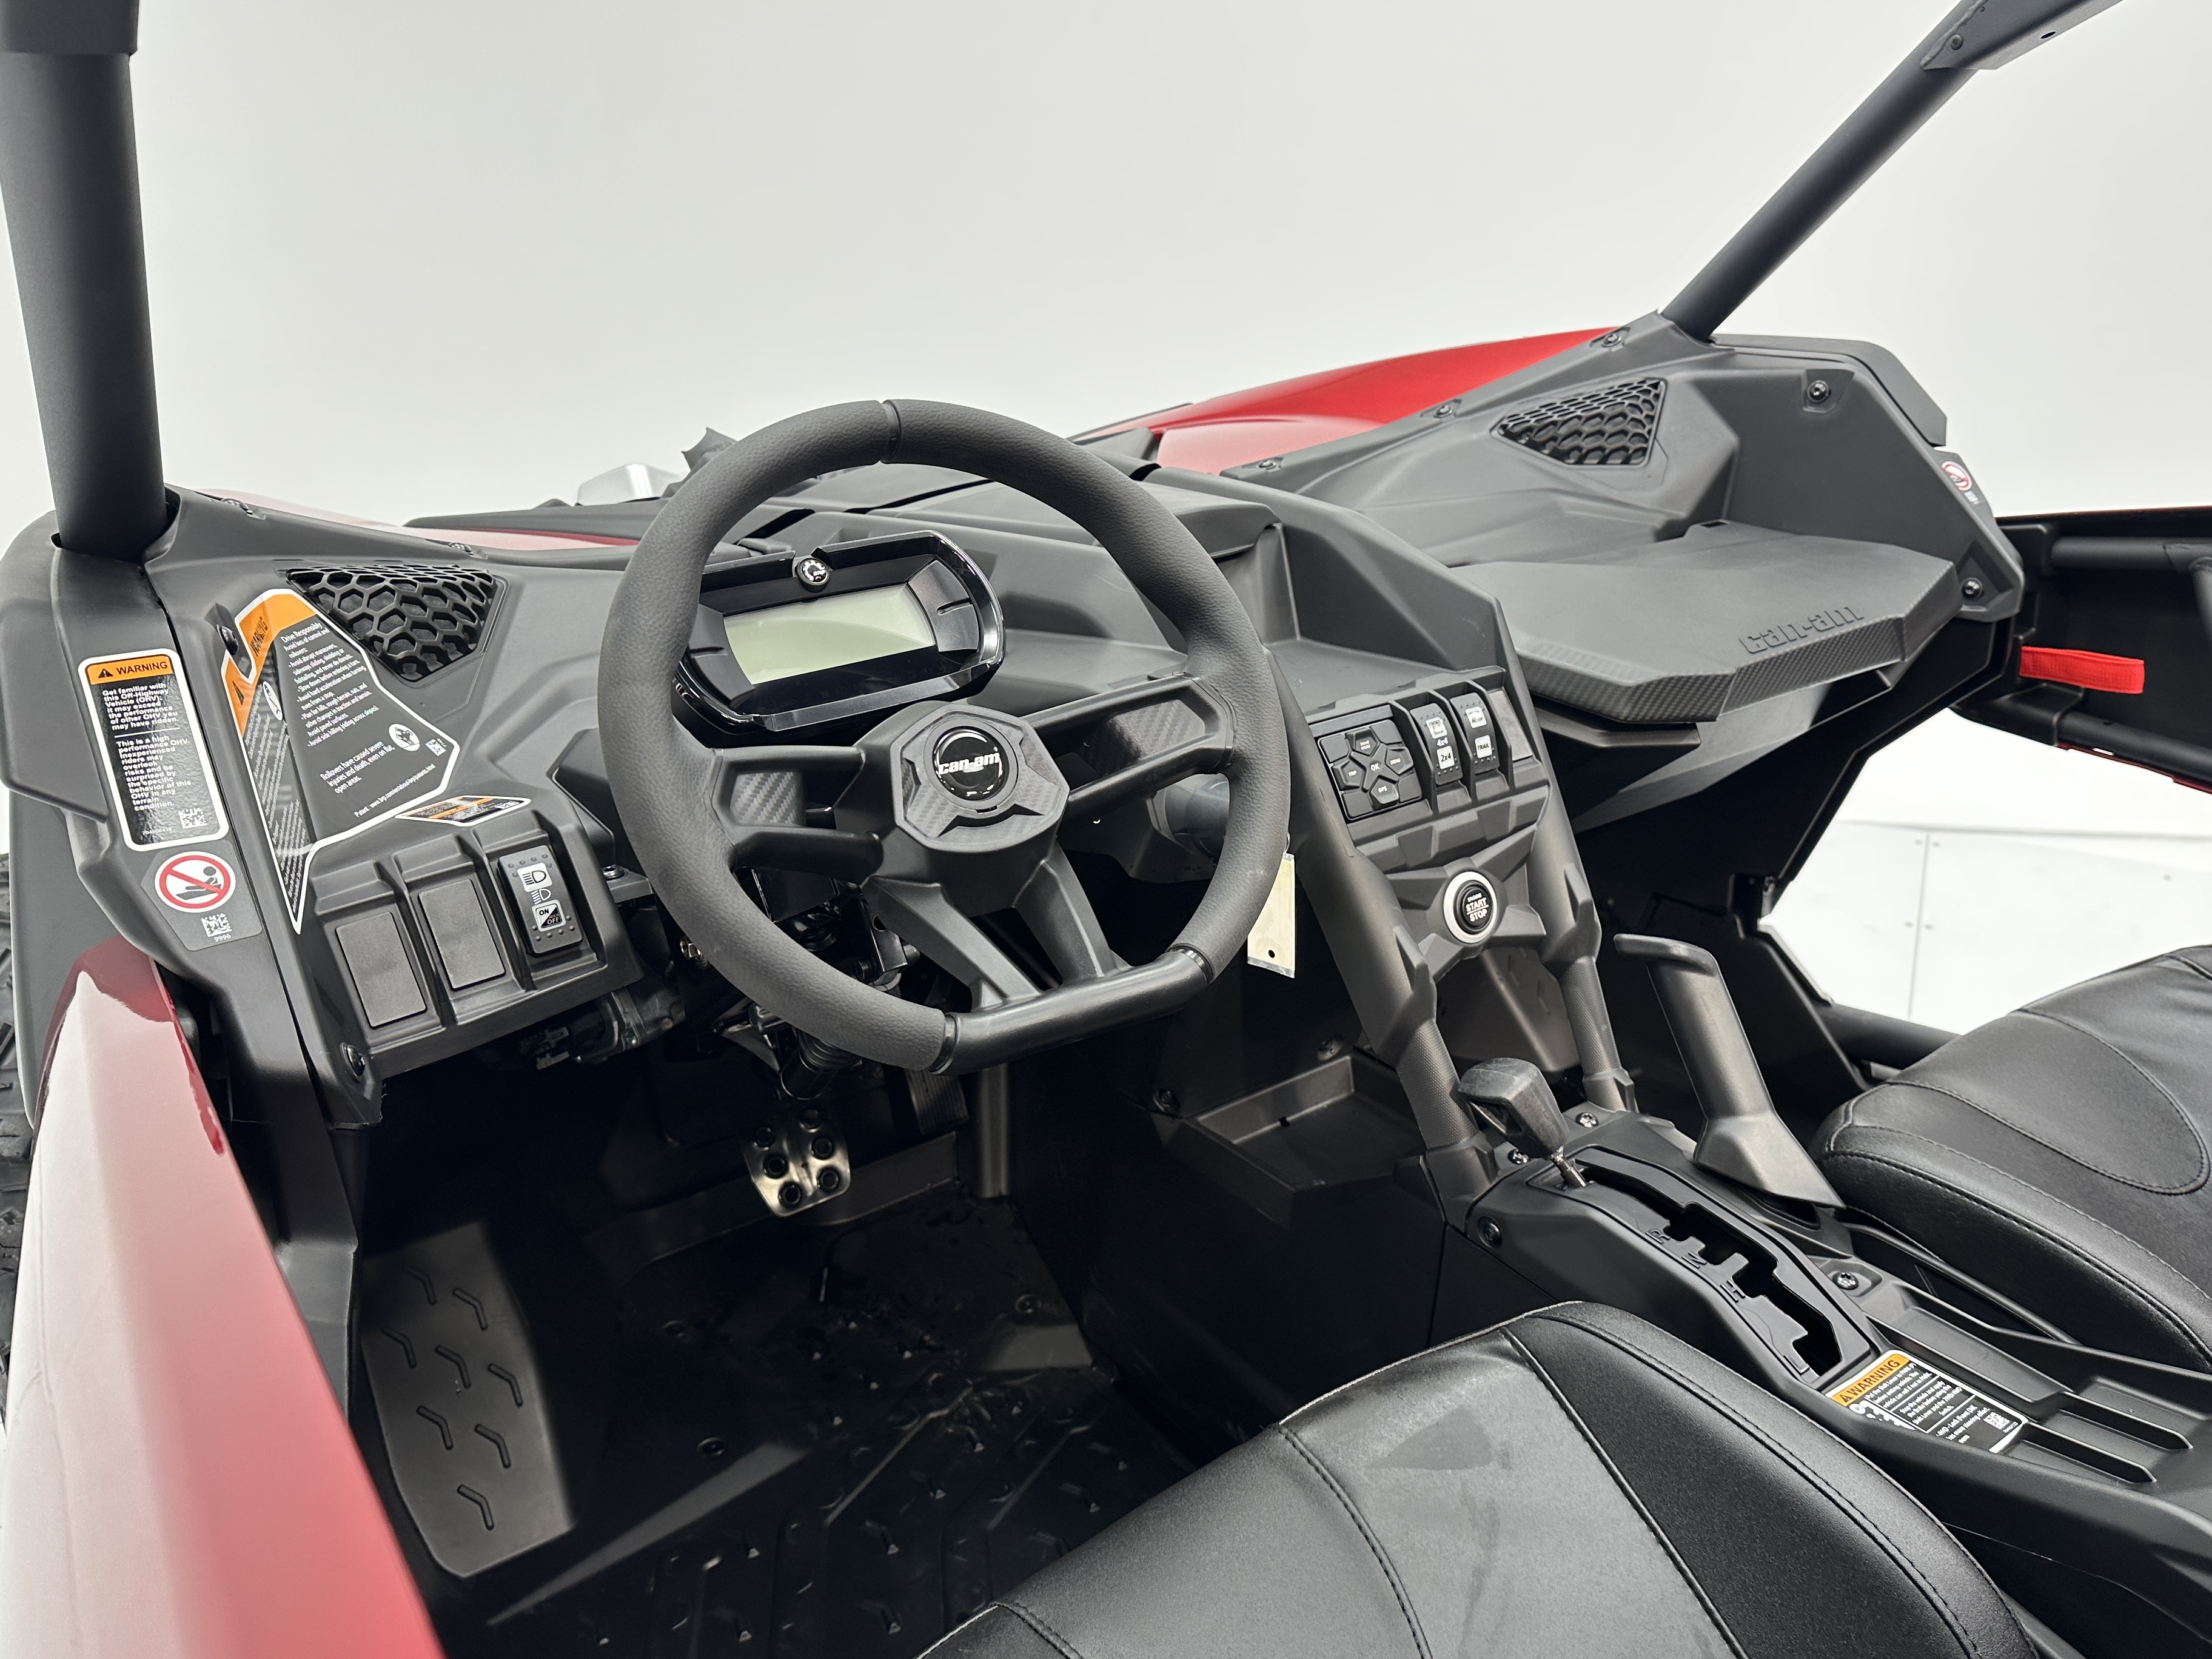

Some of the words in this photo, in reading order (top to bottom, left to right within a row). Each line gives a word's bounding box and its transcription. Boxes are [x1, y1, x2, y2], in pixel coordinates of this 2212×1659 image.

[281, 632, 296, 643] Drive
[293, 622, 323, 638] Responsibly
[1738, 607, 1865, 654] can-am
[284, 642, 297, 651] Avoid
[308, 631, 323, 640] control
[290, 658, 303, 667] Avoid
[302, 652, 316, 662] abrupt
[116, 662, 167, 675] WARNING
[293, 664, 312, 675] sideways
[315, 667, 324, 675] and
[309, 677, 321, 686] down
[319, 673, 333, 682] before
[332, 665, 349, 675] entering
[118, 685, 148, 694] familiar
[298, 691, 312, 702] Avoid
[309, 688, 320, 697] hard
[319, 677, 343, 691] acceleration
[341, 671, 353, 680] when
[121, 689, 168, 699] Off-Highway
[301, 701, 313, 710] even
[326, 697, 339, 707] rough
[124, 706, 173, 717] performance
[317, 709, 333, 722] changes
[335, 702, 352, 712] traction
[307, 727, 321, 737] Avoid
[319, 720, 332, 732] paved
[309, 736, 323, 746] Avoid
[321, 731, 330, 740] side
[353, 712, 366, 723] across
[118, 742, 169, 752] performance
[1437, 737, 1448, 746] 4x4
[119, 746, 175, 759] Inexperienced
[1441, 752, 1452, 762] 2x4
[123, 761, 158, 771] overlook
[320, 763, 344, 780] Rollovers
[340, 759, 355, 769] have
[353, 748, 370, 761] caused
[368, 742, 384, 753] severe
[327, 774, 347, 786] injuries
[345, 767, 356, 777] and
[354, 760, 370, 771] death,
[368, 754, 380, 763] even
[378, 748, 386, 757] on
[384, 745, 396, 755] flat,
[938, 752, 1000, 774] can-am
[1370, 763, 1380, 771] OK
[126, 773, 164, 782] surprised
[142, 777, 173, 786] specific
[129, 784, 164, 794] behavior
[335, 783, 349, 793] open
[346, 776, 361, 786] areas.
[134, 801, 175, 811] condition.
[1466, 897, 1486, 912] START
[1469, 909, 1487, 922] STOP
[1644, 1228, 1671, 1244] R
[1681, 1250, 1708, 1269] N
[1720, 1280, 1746, 1304] H
[1847, 1359, 1900, 1396] WARNING
